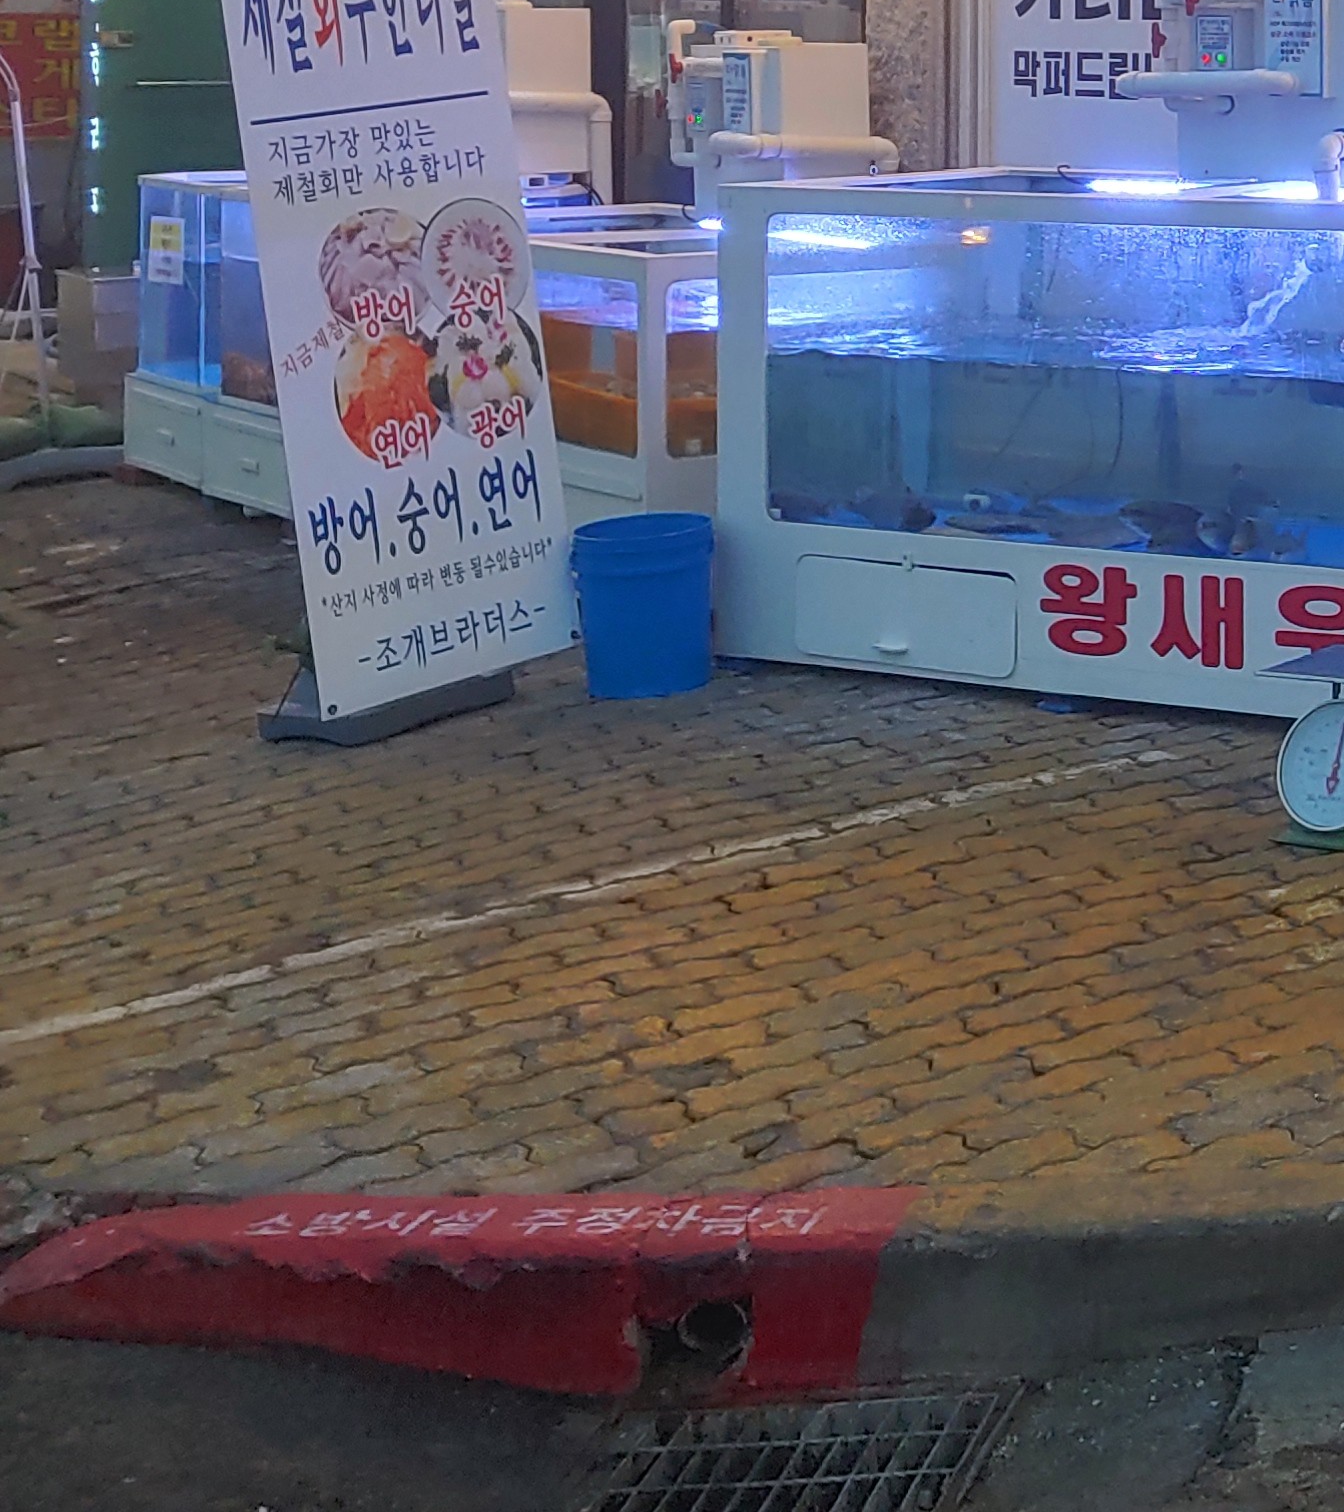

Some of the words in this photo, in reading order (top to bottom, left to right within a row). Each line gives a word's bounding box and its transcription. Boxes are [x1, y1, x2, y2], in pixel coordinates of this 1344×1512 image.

[1013, 50, 1153, 101] 막퍼드립
[268, 126, 360, 168] 지금가장
[369, 118, 436, 155] 맛있는
[273, 166, 364, 206] 제철회만
[373, 145, 486, 190] 사용합니다
[354, 285, 415, 338] 방어
[450, 276, 505, 330] 숭어
[374, 415, 430, 470] 연어
[470, 398, 527, 449] 광어
[308, 448, 542, 576] 방어.숭어.연어
[362, 577, 402, 607] 사정에
[406, 568, 435, 595] 따라
[439, 560, 467, 587] 변동
[357, 599, 546, 672] -조개브라더스-
[243, 1207, 498, 1237] 소방시설
[511, 1204, 829, 1237] 주정차금지
